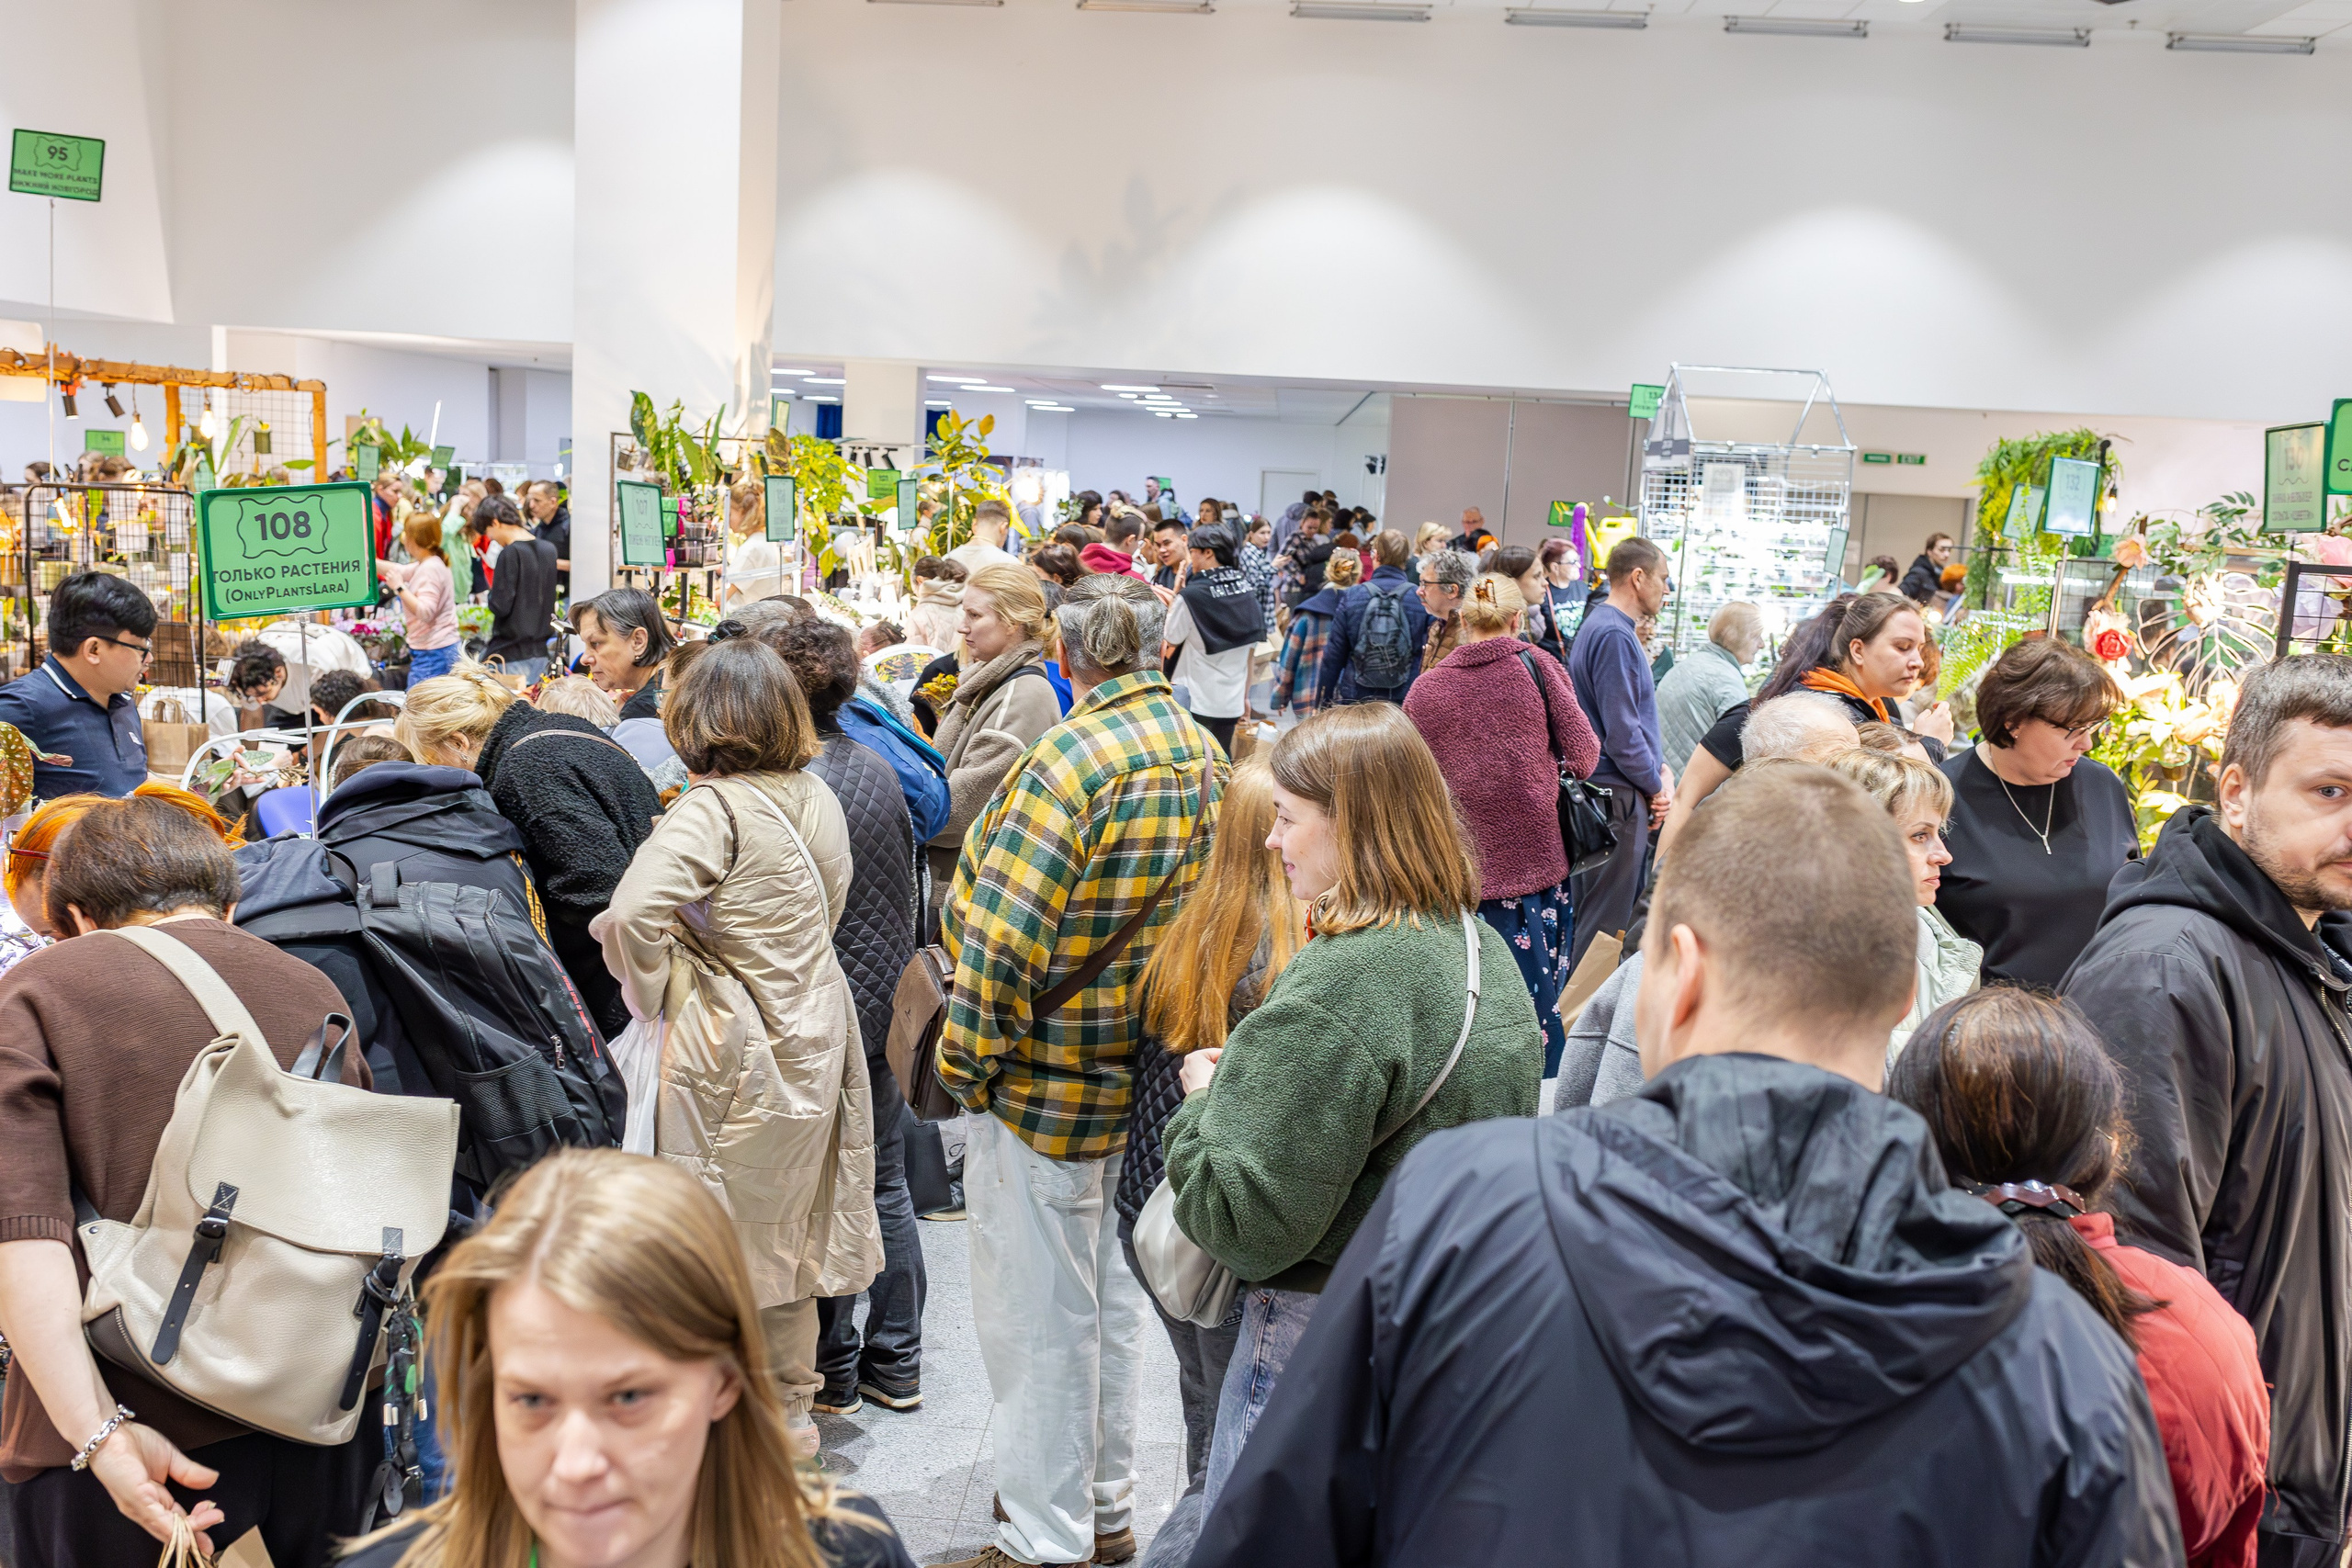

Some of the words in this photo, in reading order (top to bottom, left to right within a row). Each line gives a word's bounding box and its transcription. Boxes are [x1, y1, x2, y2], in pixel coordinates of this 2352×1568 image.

[48, 146, 68, 161] 95
[40, 172, 64, 180] MORE
[66, 175, 97, 185] PLANTS
[254, 511, 311, 540] 108
[213, 566, 276, 584] ТОЛЬКО
[281, 559, 361, 579] РАСТЕНИЯ
